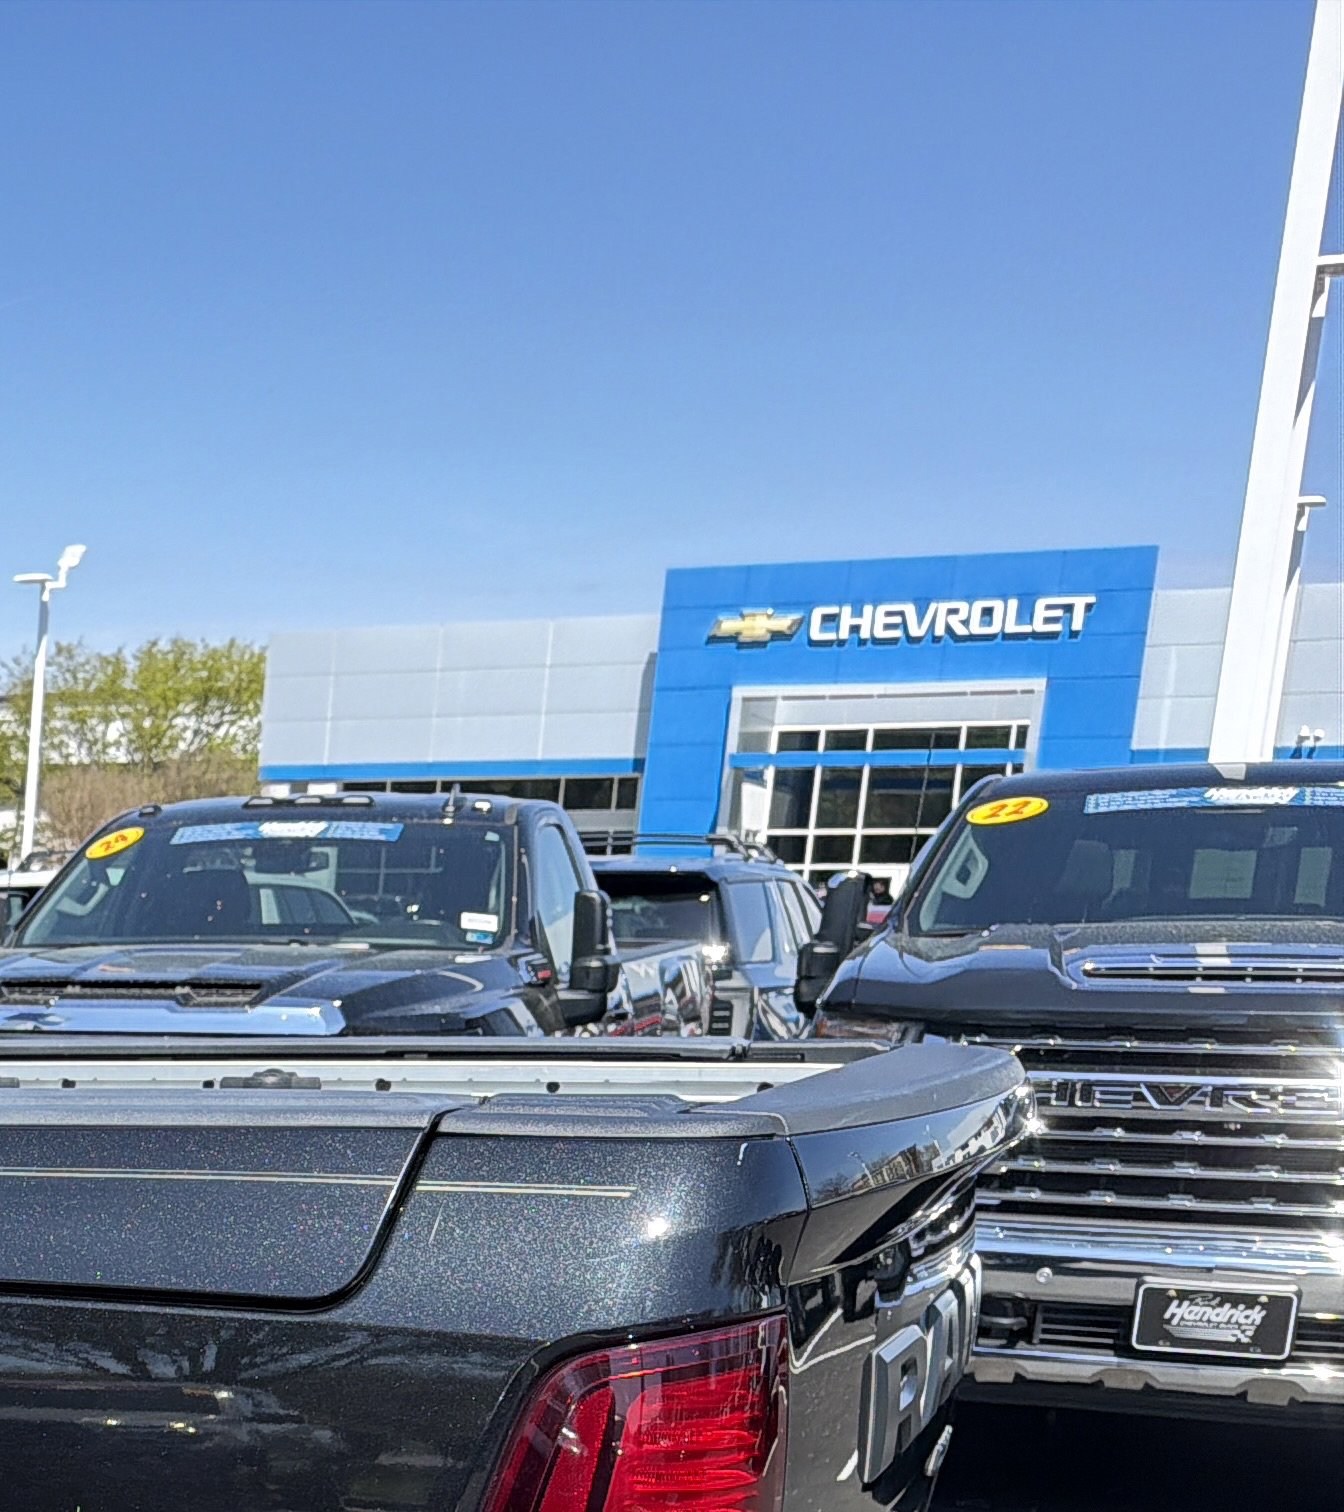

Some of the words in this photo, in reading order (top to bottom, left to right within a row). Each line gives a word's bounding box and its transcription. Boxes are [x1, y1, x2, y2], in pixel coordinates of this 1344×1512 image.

[808, 595, 1097, 643] CHEVROLET
[982, 800, 1031, 820] 22
[1163, 1299, 1267, 1326] Hendrick
